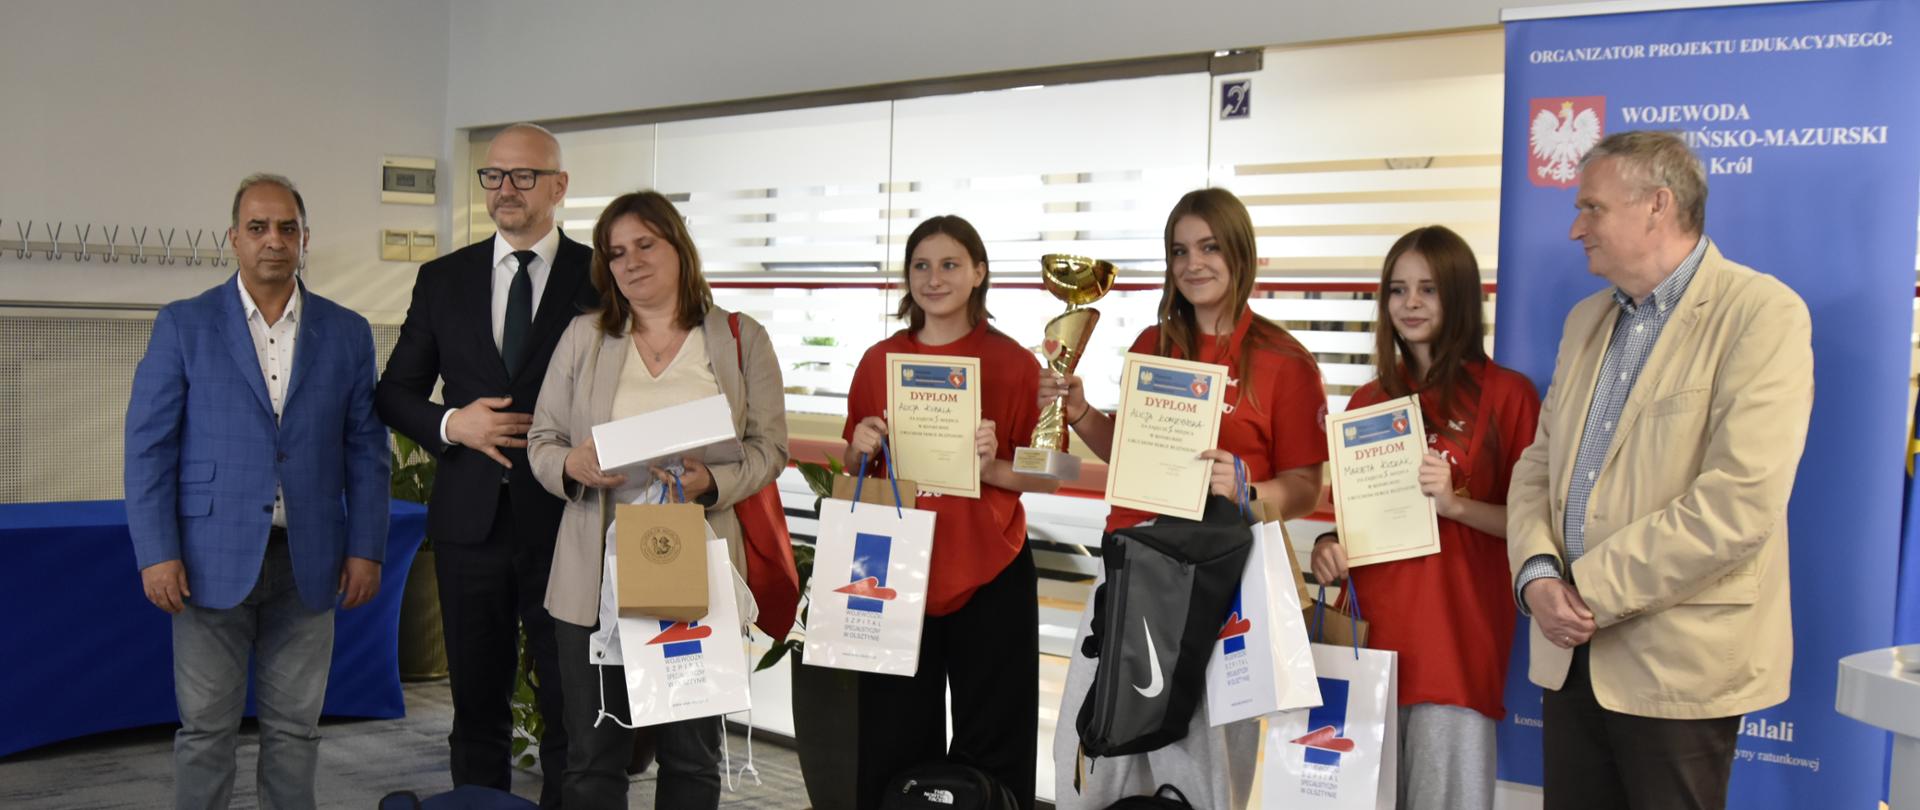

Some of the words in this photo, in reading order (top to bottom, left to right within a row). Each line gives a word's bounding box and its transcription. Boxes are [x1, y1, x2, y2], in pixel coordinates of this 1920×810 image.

[1529, 45, 1646, 64] ORGANIZATOR
[1648, 40, 1736, 58] PROJEKTU
[1740, 32, 1894, 53] EDUKACYJNEGO:
[1621, 103, 1751, 123] WOJEWODA
[1682, 126, 1889, 149] IŃSKO-MAZURSKI
[1710, 156, 1753, 175] Król
[910, 391, 958, 402] DYPLOM
[1144, 396, 1197, 413] DYPLOM
[1355, 441, 1405, 460] DYPLOM
[1514, 713, 1543, 728] konsu
[1737, 716, 1793, 742] Jalali
[1757, 751, 1820, 772] ratunkowej
